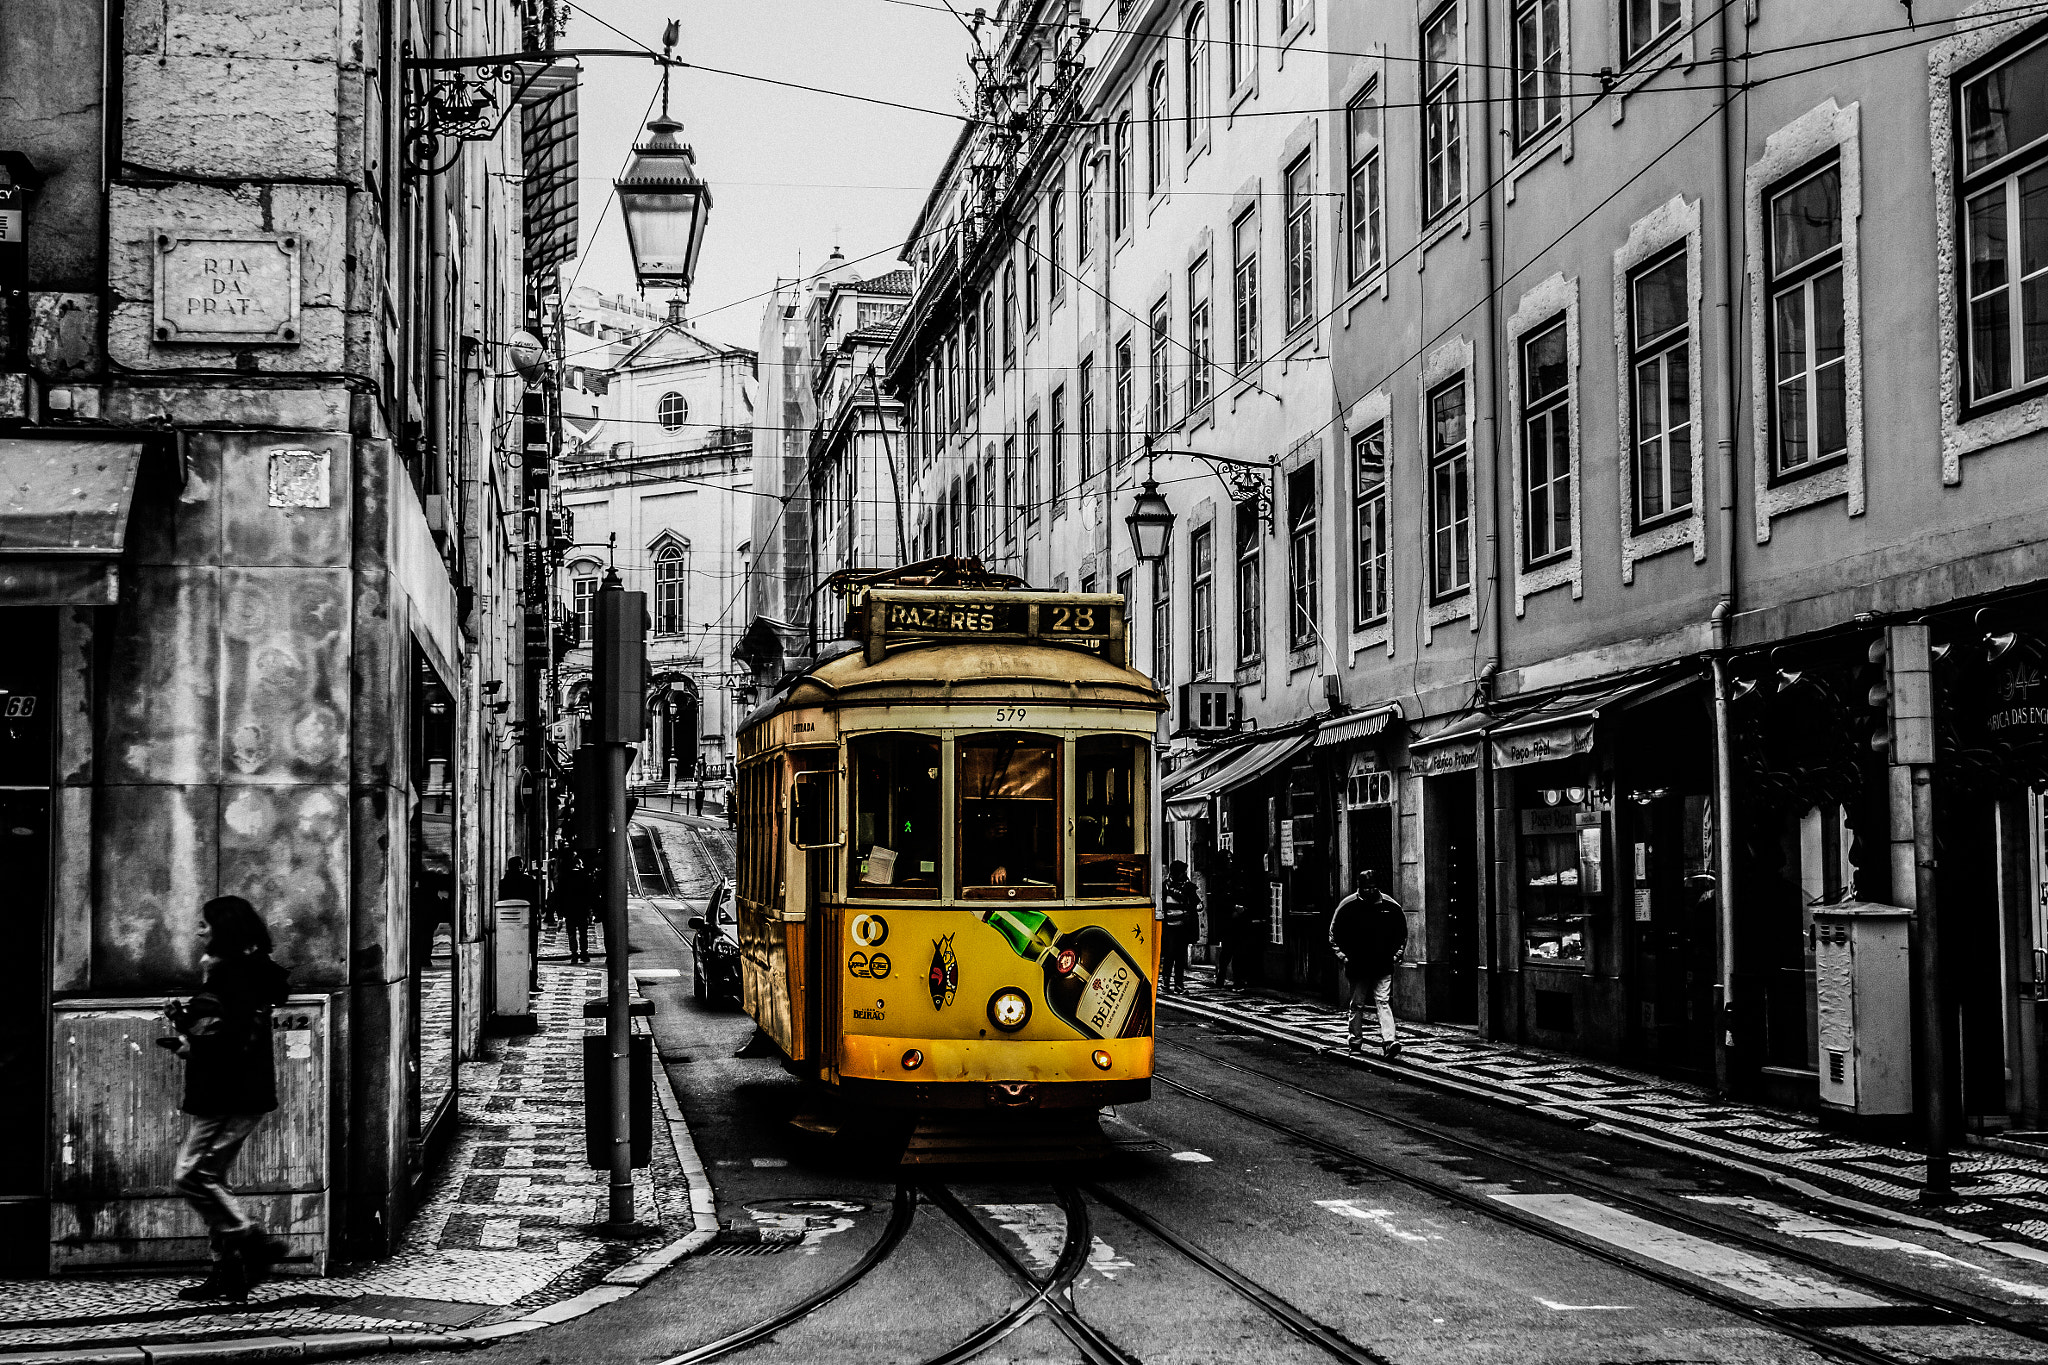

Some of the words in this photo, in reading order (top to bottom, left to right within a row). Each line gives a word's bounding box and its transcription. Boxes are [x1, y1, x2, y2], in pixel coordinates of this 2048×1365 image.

[204, 258, 250, 275] RUA
[213, 279, 243, 295] DA
[187, 298, 268, 315] PRATA
[1052, 607, 1095, 631] 28
[6, 697, 36, 716] 68
[996, 709, 1027, 722] 579
[2012, 708, 2028, 724] DAS
[1511, 745, 1530, 763] Paço
[1533, 740, 1551, 758] Real
[1090, 966, 1128, 1030] BEIRÃO
[853, 1009, 885, 1021] BEIRÃO
